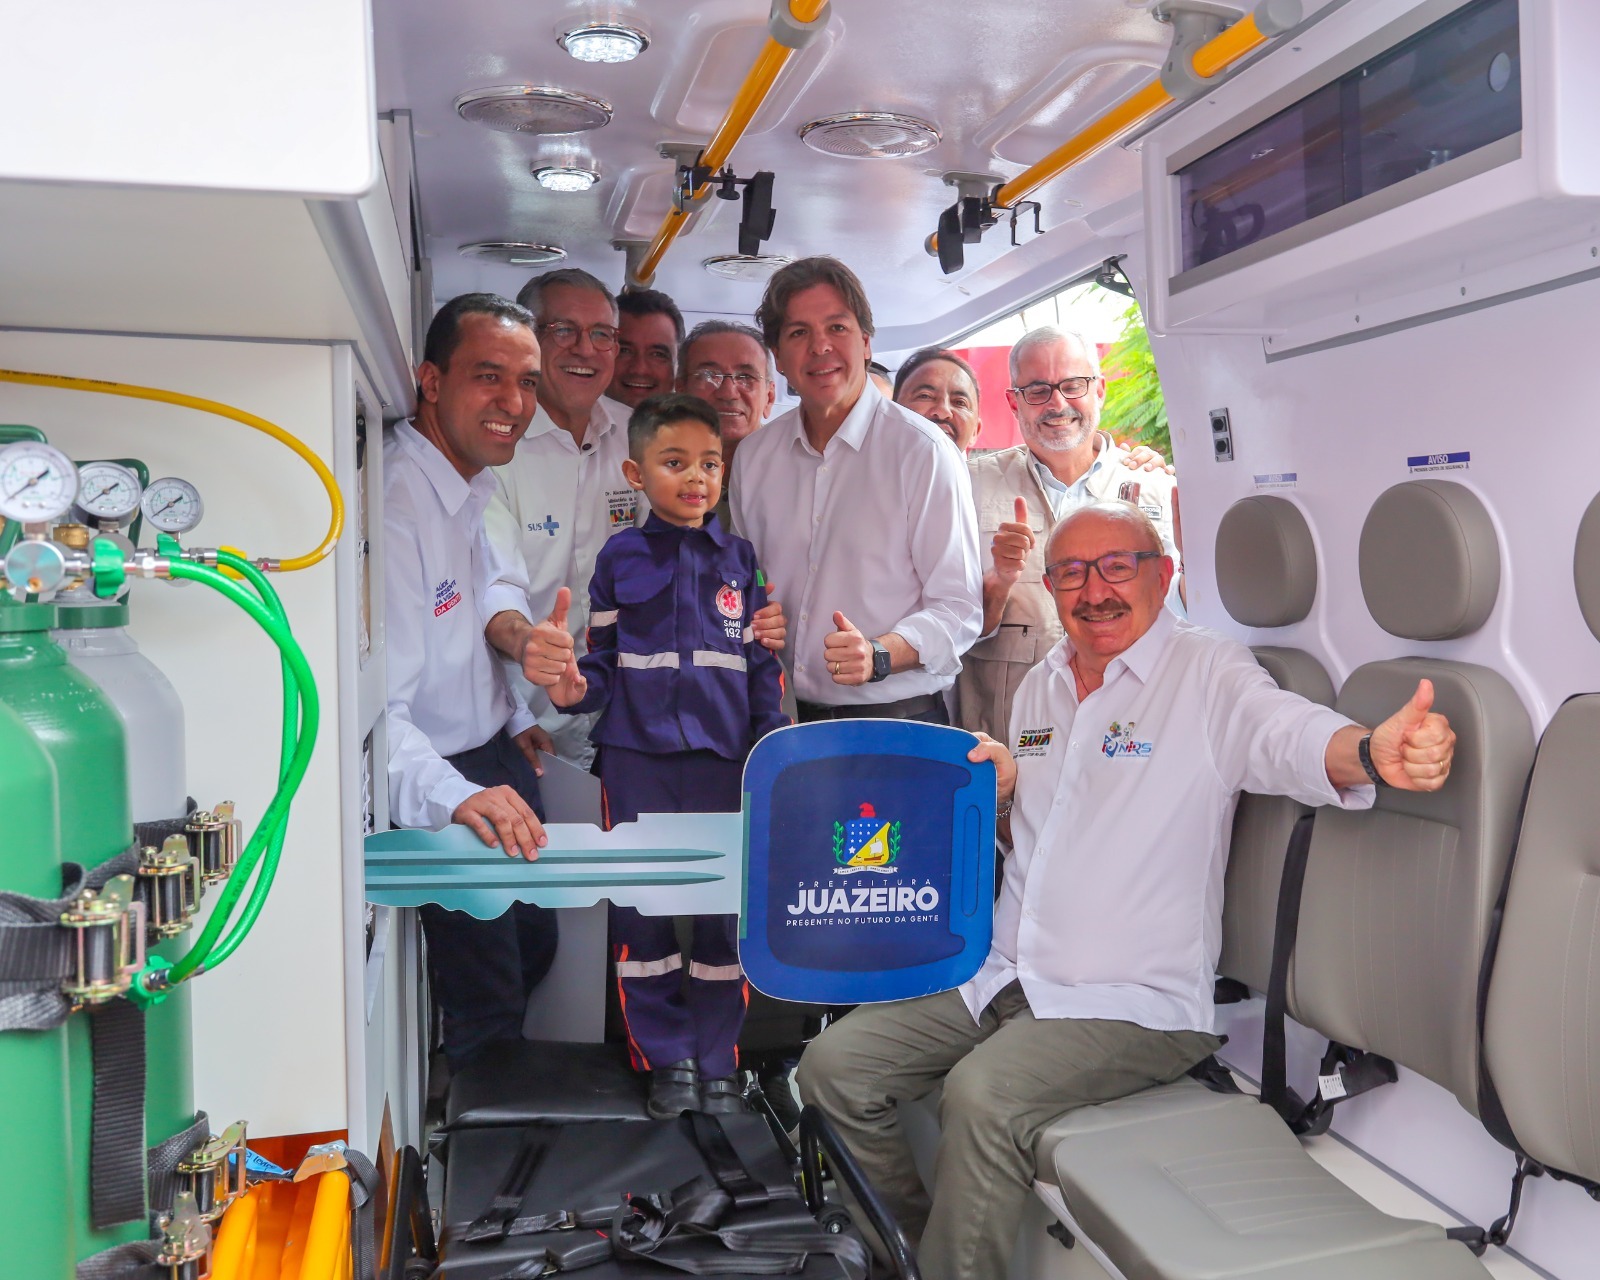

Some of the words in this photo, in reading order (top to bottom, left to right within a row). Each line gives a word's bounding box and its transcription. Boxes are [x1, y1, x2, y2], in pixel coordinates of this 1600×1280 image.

[1427, 454, 1449, 465] AVISO
[527, 522, 543, 532] SUS
[435, 606, 448, 616] DA
[724, 627, 741, 638] 192
[798, 878, 931, 888] PREFEITURA
[787, 886, 939, 915] JUAZEIRO
[786, 918, 834, 927] PRESENTE
[837, 917, 851, 925] NO
[855, 916, 891, 924] FUTURO
[910, 915, 939, 923] GENTE
